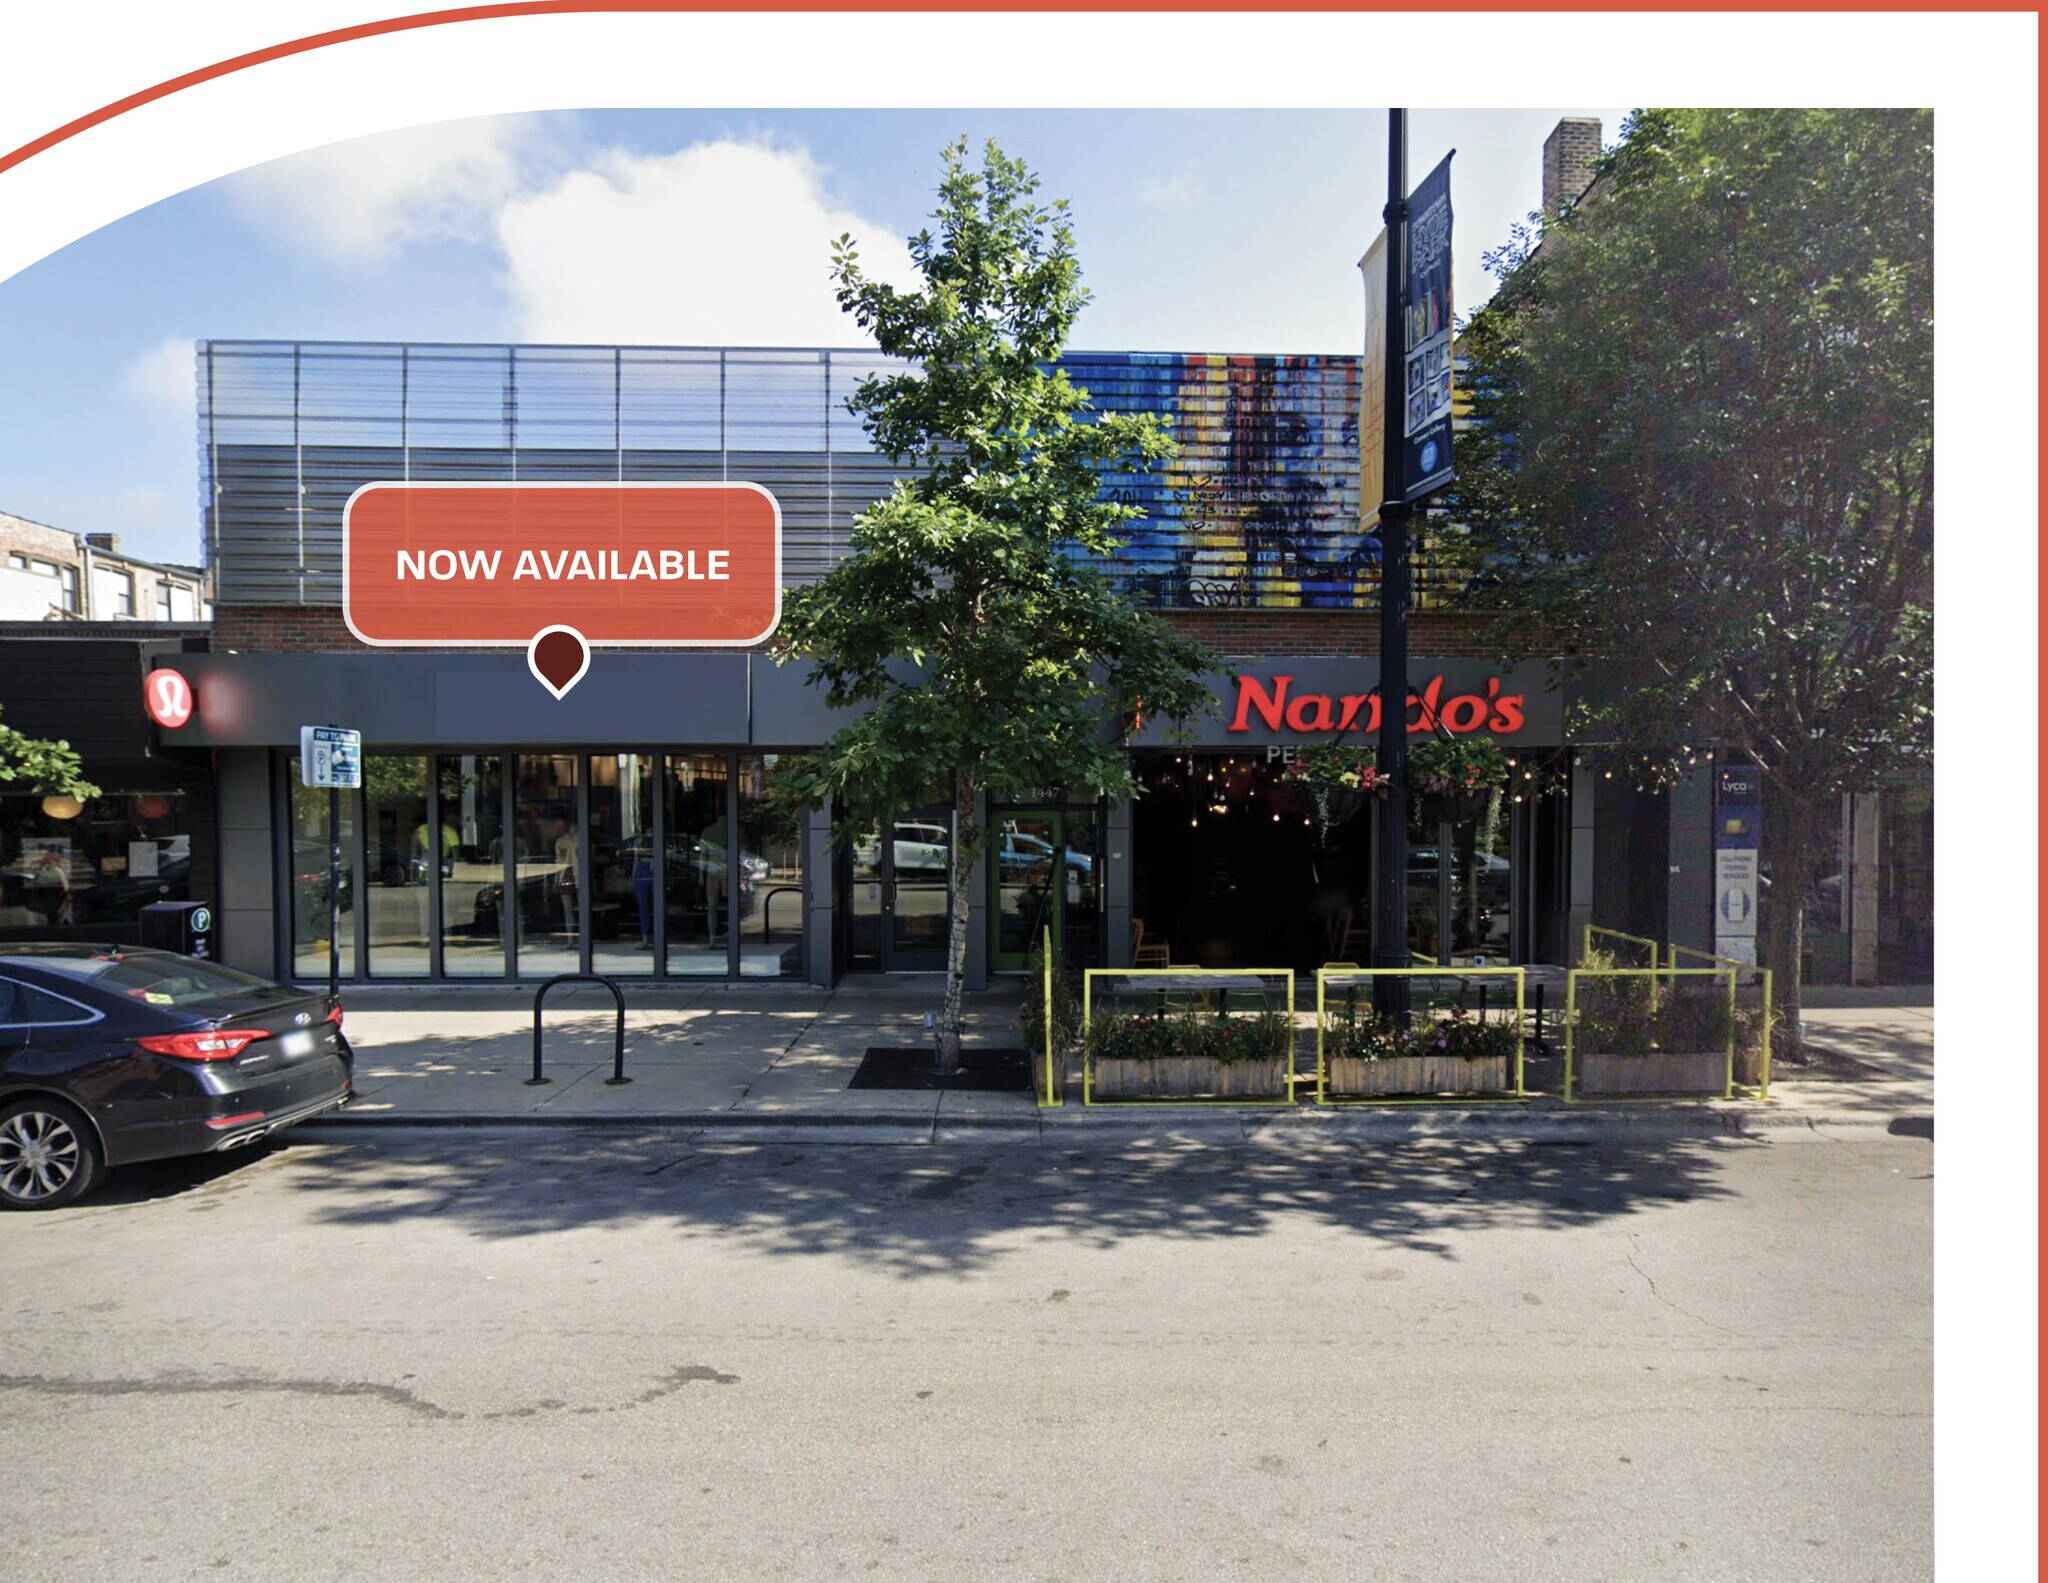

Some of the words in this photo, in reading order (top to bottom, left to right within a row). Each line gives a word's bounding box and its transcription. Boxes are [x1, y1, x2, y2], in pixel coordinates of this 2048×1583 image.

[1412, 225, 1449, 274] PARK
[1227, 675, 1525, 734] Nando's
[315, 730, 329, 741] PAY
[329, 731, 340, 742] TO
[340, 731, 358, 743] PARK
[1031, 785, 1060, 799] 1447
[1722, 780, 1748, 793] Lyca
[198, 911, 206, 929] P
